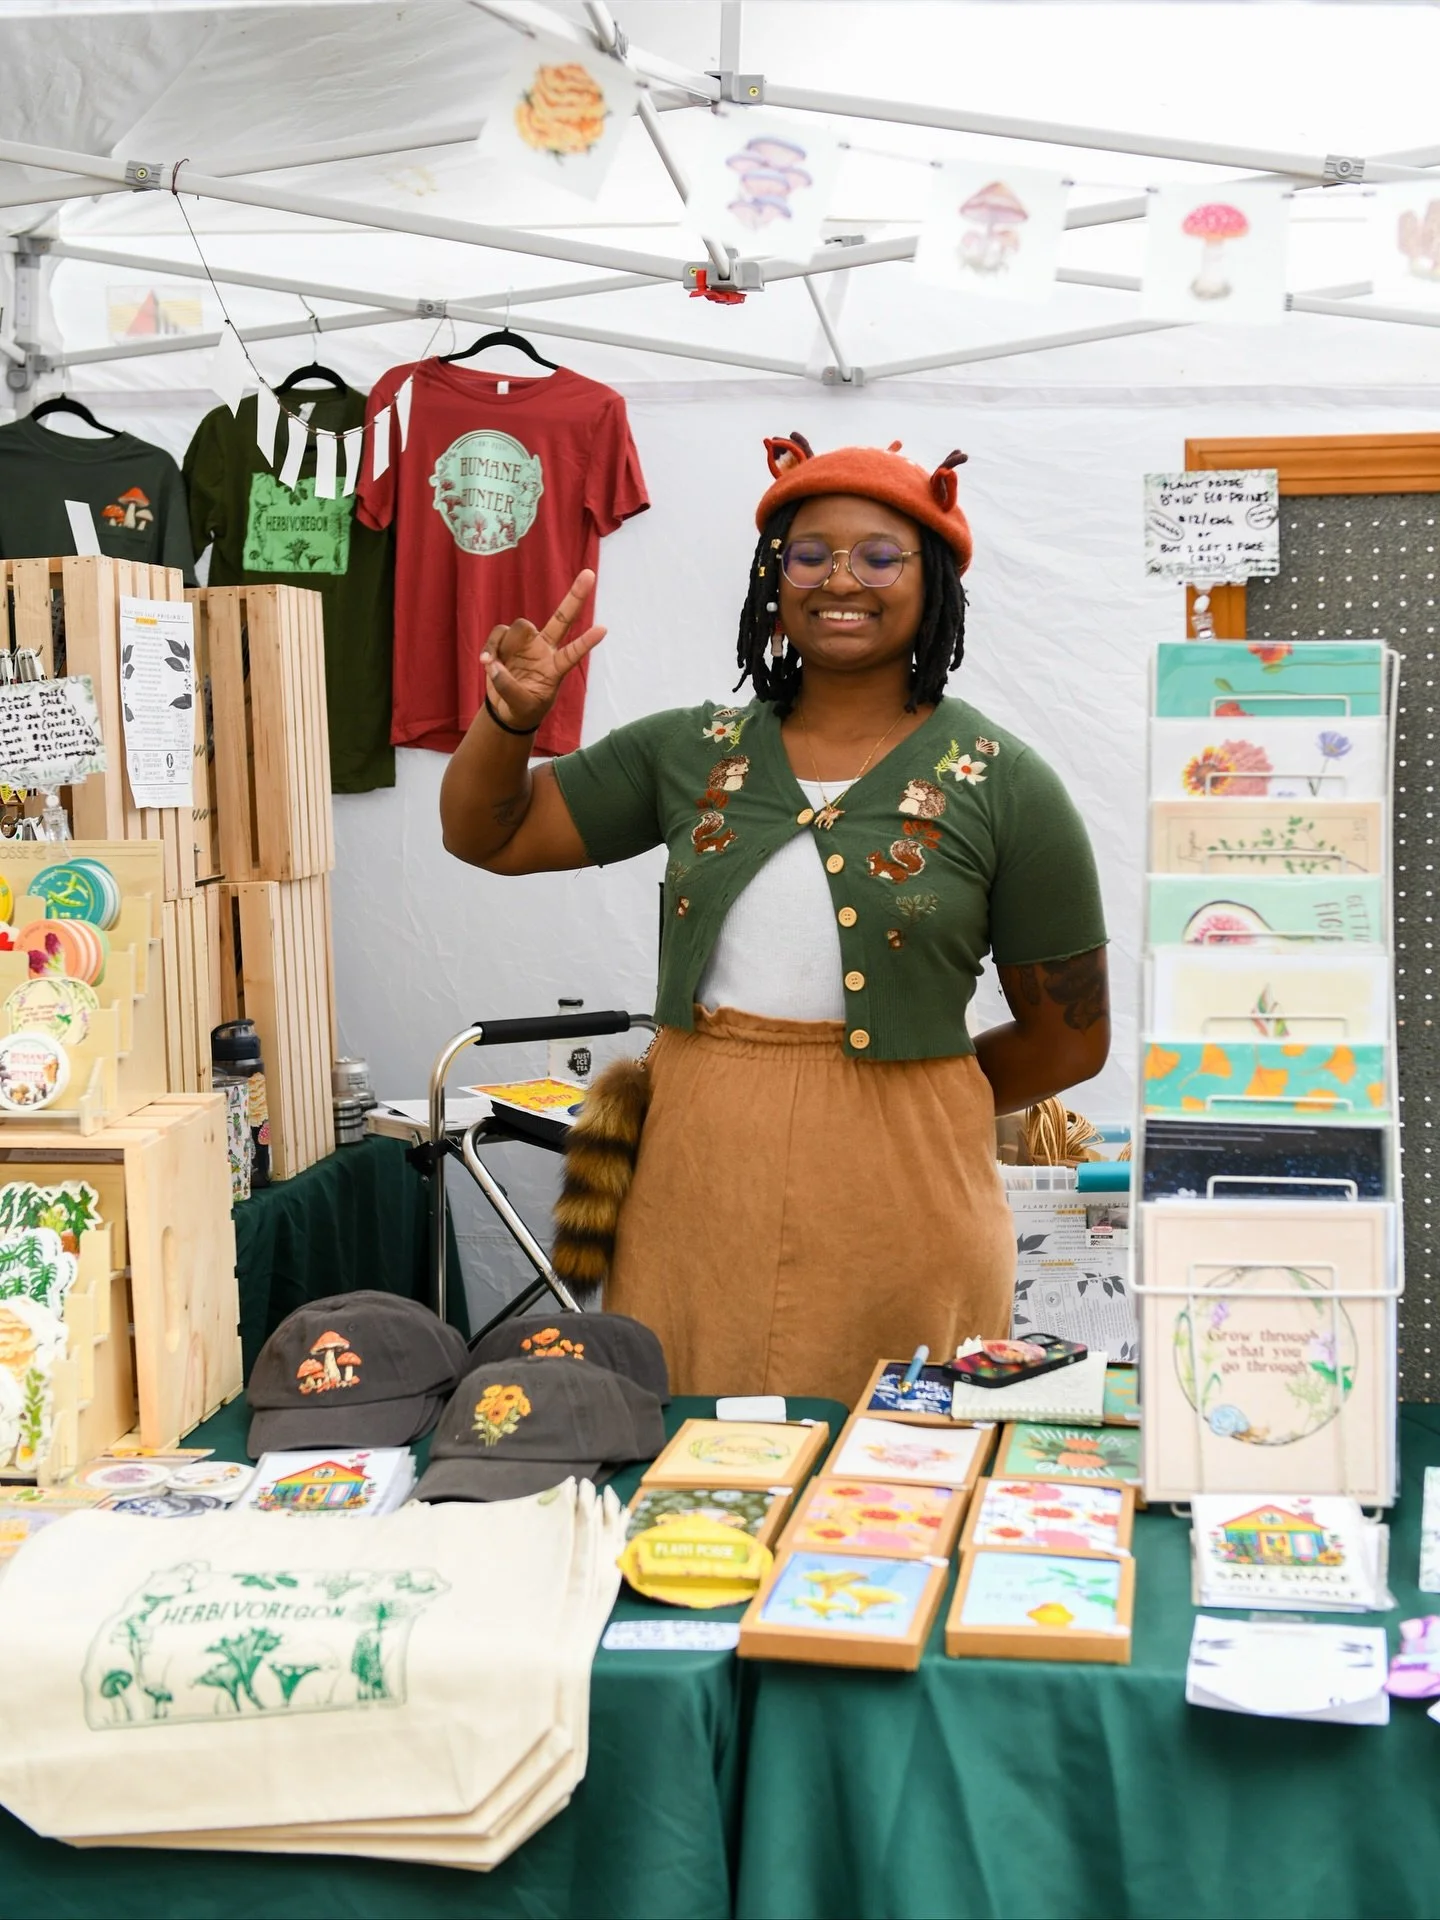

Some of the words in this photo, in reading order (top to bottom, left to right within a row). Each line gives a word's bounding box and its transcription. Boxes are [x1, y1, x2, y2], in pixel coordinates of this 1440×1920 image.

[460, 457, 522, 484] HUMANE
[462, 488, 515, 514] HUNTER
[266, 515, 328, 532] HERBIVOREGON
[1207, 1329, 1252, 1341] Grow
[1260, 1329, 1319, 1345] through
[1227, 1343, 1264, 1357] what
[1273, 1347, 1302, 1360] you
[1221, 1361, 1240, 1374] go
[1246, 1359, 1307, 1377] through
[1069, 1466, 1117, 1478] YOU
[1280, 1571, 1351, 1584] SPACE
[160, 1600, 346, 1624] HERBIVOREGON
